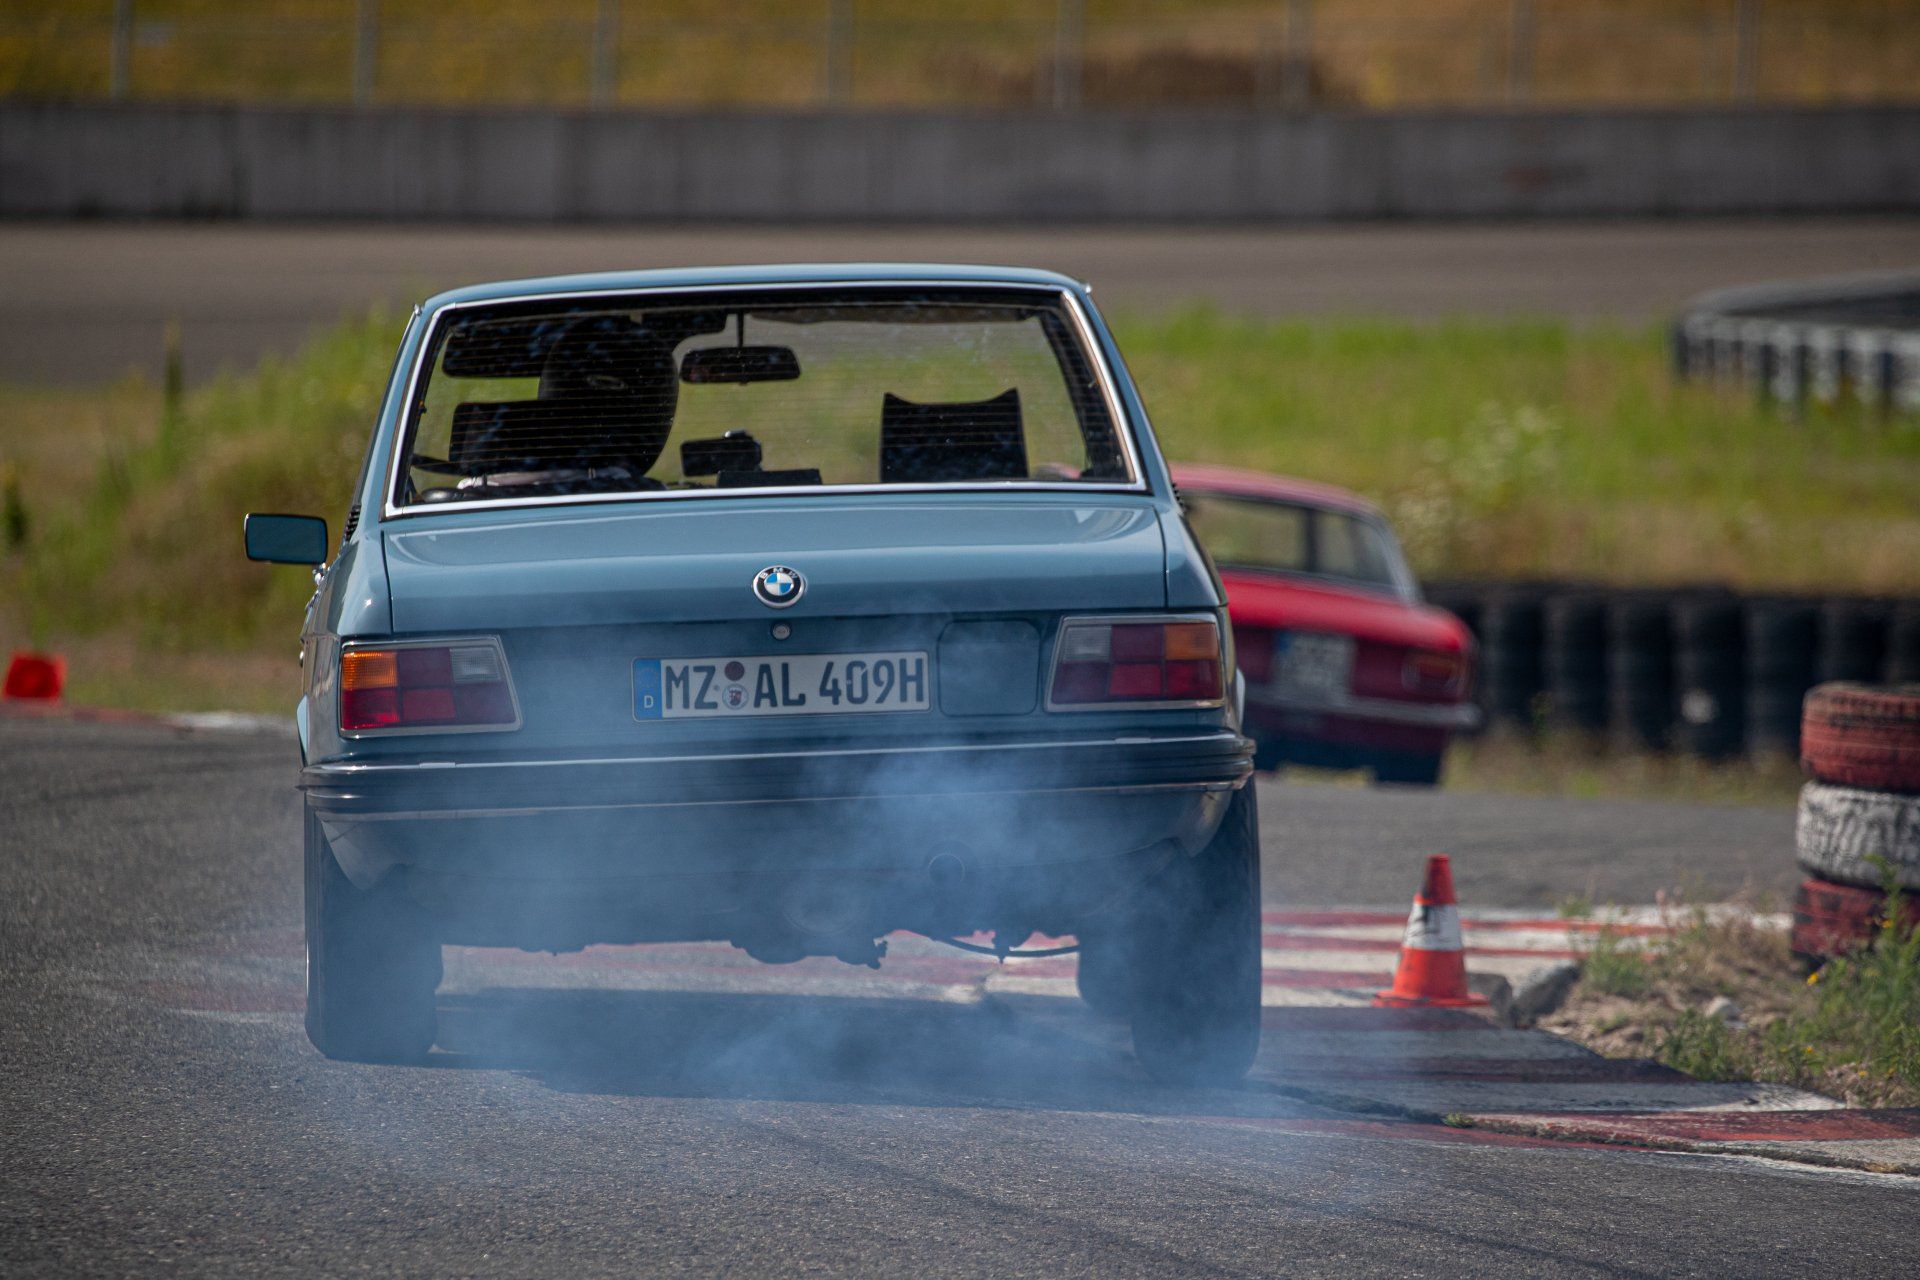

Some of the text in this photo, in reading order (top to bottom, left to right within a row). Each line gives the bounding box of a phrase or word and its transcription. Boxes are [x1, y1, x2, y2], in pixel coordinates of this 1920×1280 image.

[664, 658, 924, 710] MZ AL 409H
[643, 695, 654, 709] D
